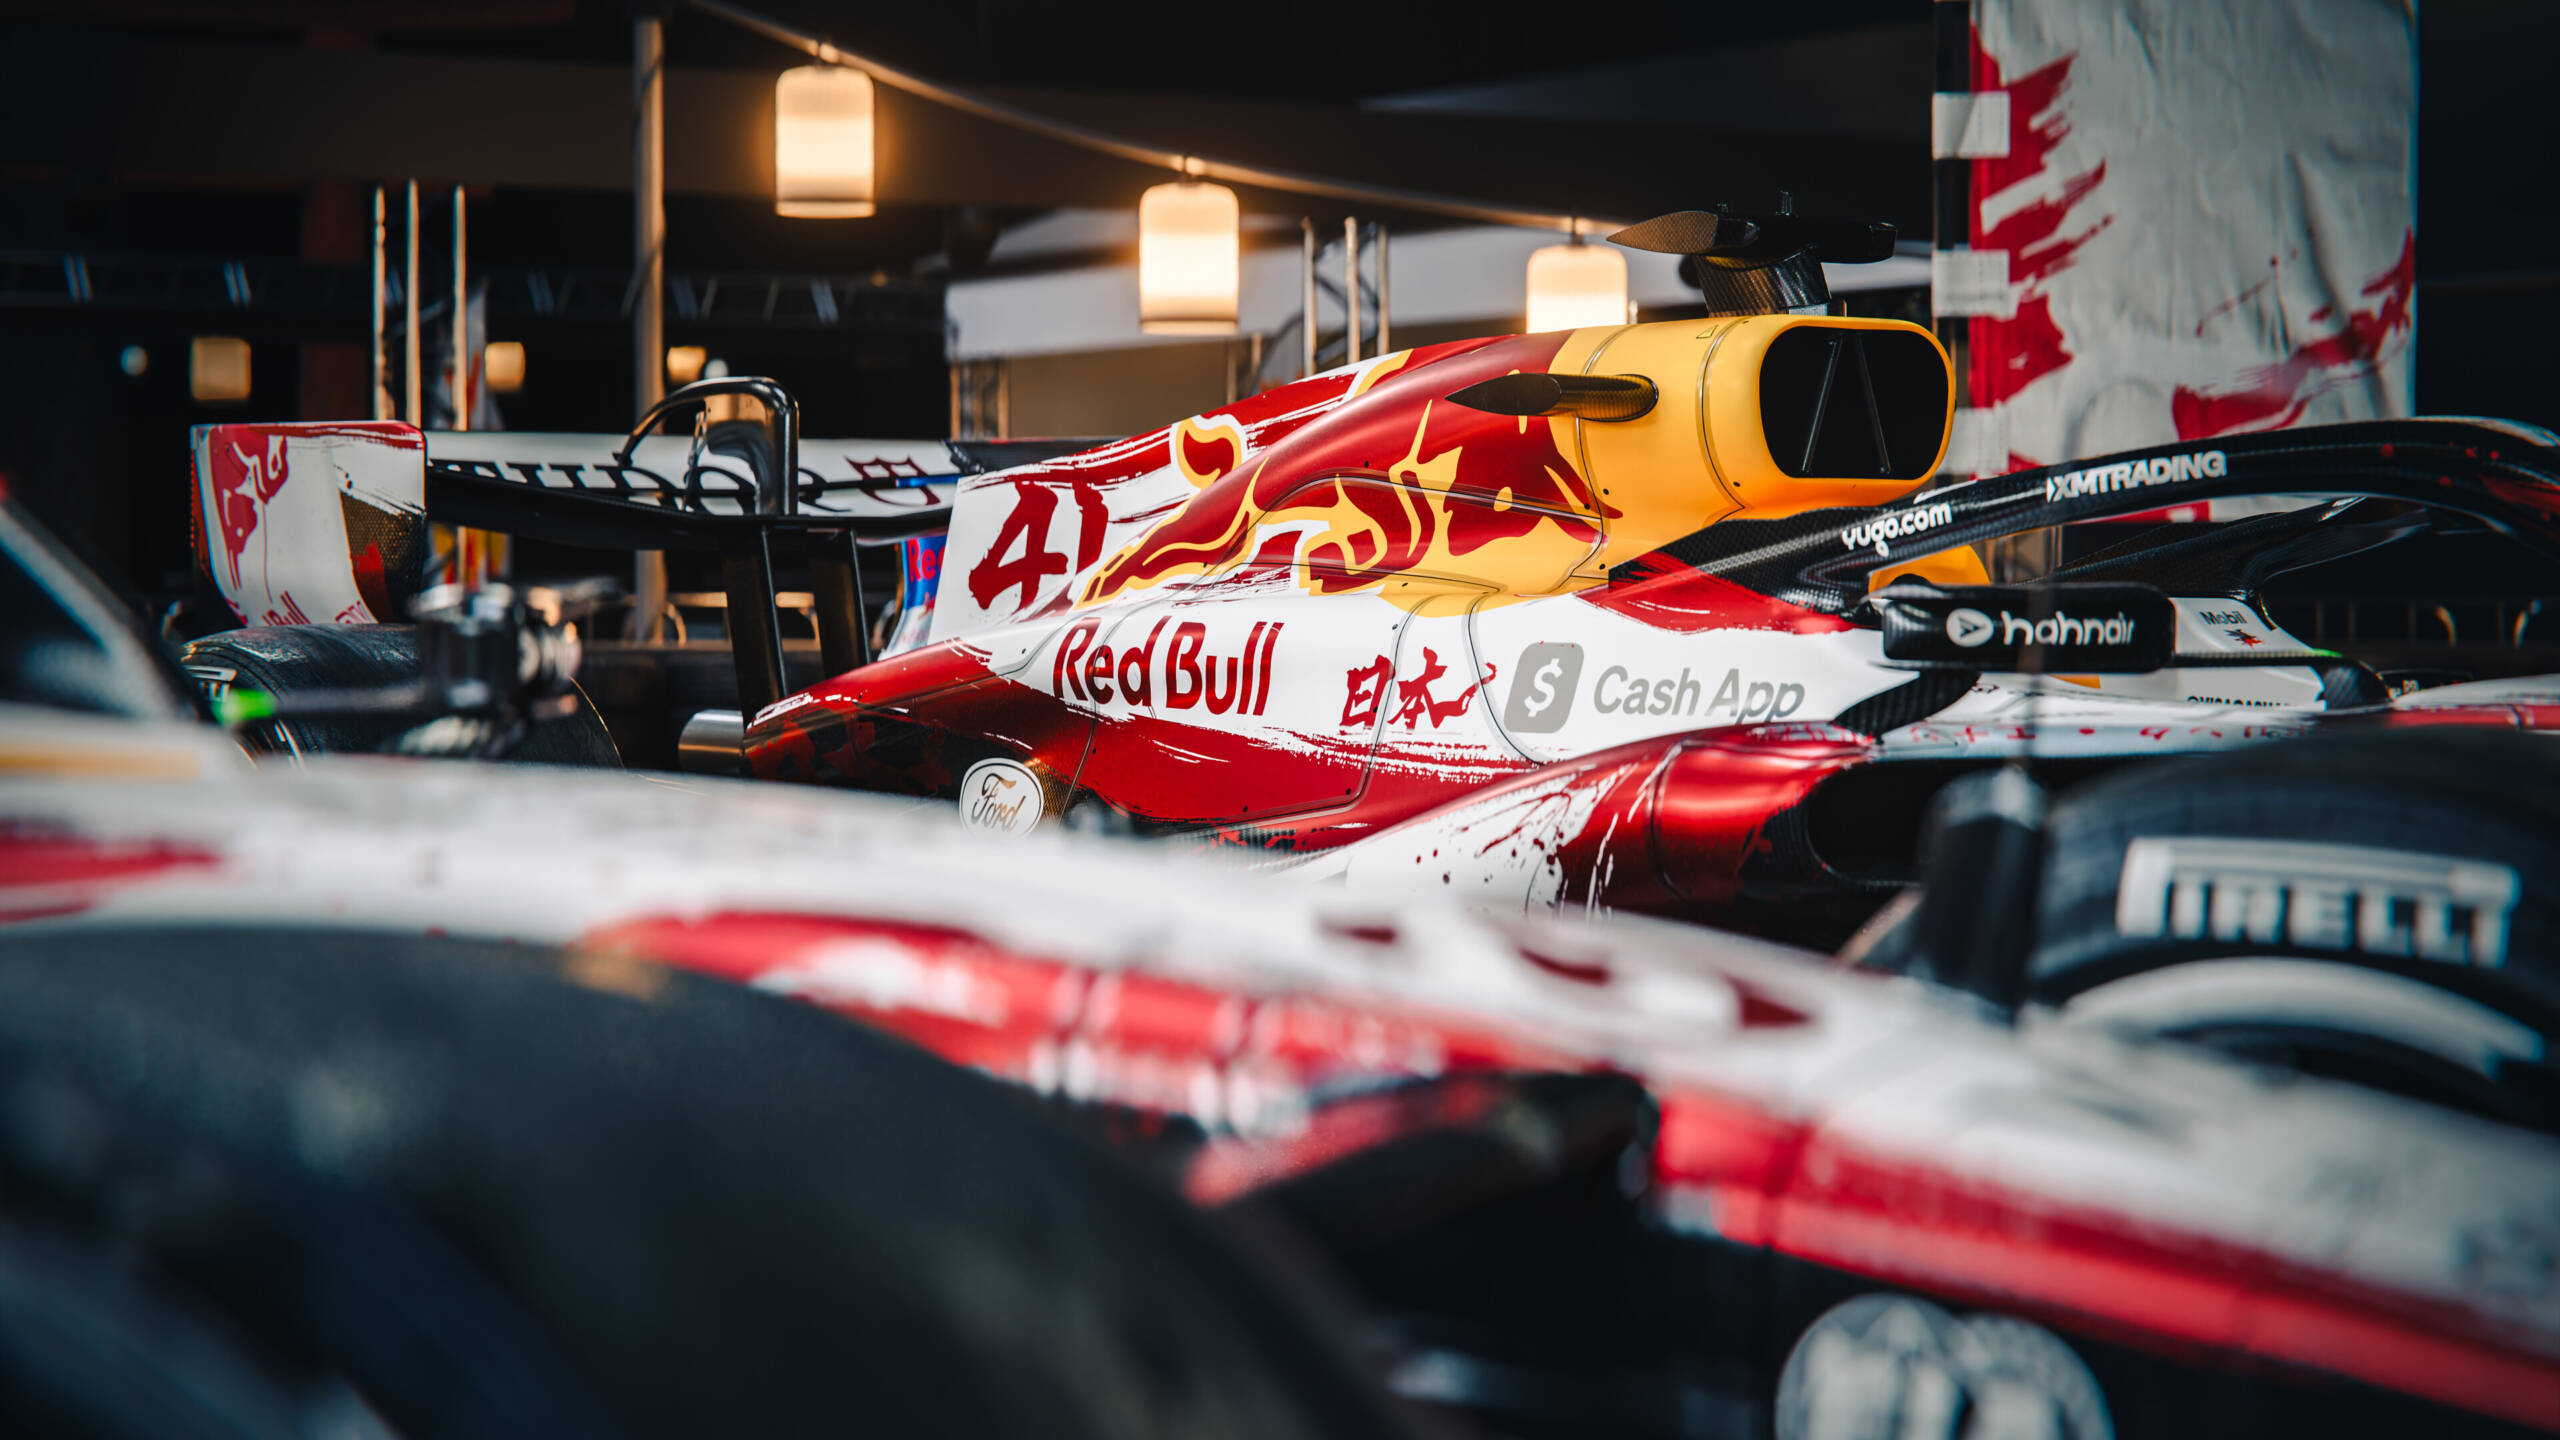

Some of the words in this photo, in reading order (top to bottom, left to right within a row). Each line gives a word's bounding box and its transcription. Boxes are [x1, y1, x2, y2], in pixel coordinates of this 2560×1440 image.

[2047, 450, 2226, 502] XMTRADING
[1842, 503, 1953, 557] yugo.com
[907, 538, 946, 582] Re
[2001, 610, 2135, 646] hahnair
[2199, 610, 2248, 625] Mobil
[1053, 616, 1173, 707] Red
[1165, 621, 1285, 716] Bull
[1339, 646, 1497, 731] 日本
[1593, 665, 1701, 716] Cash
[1704, 668, 1806, 725] App
[970, 772, 1026, 833] Ford
[2115, 837, 2521, 969] PIRELLI
